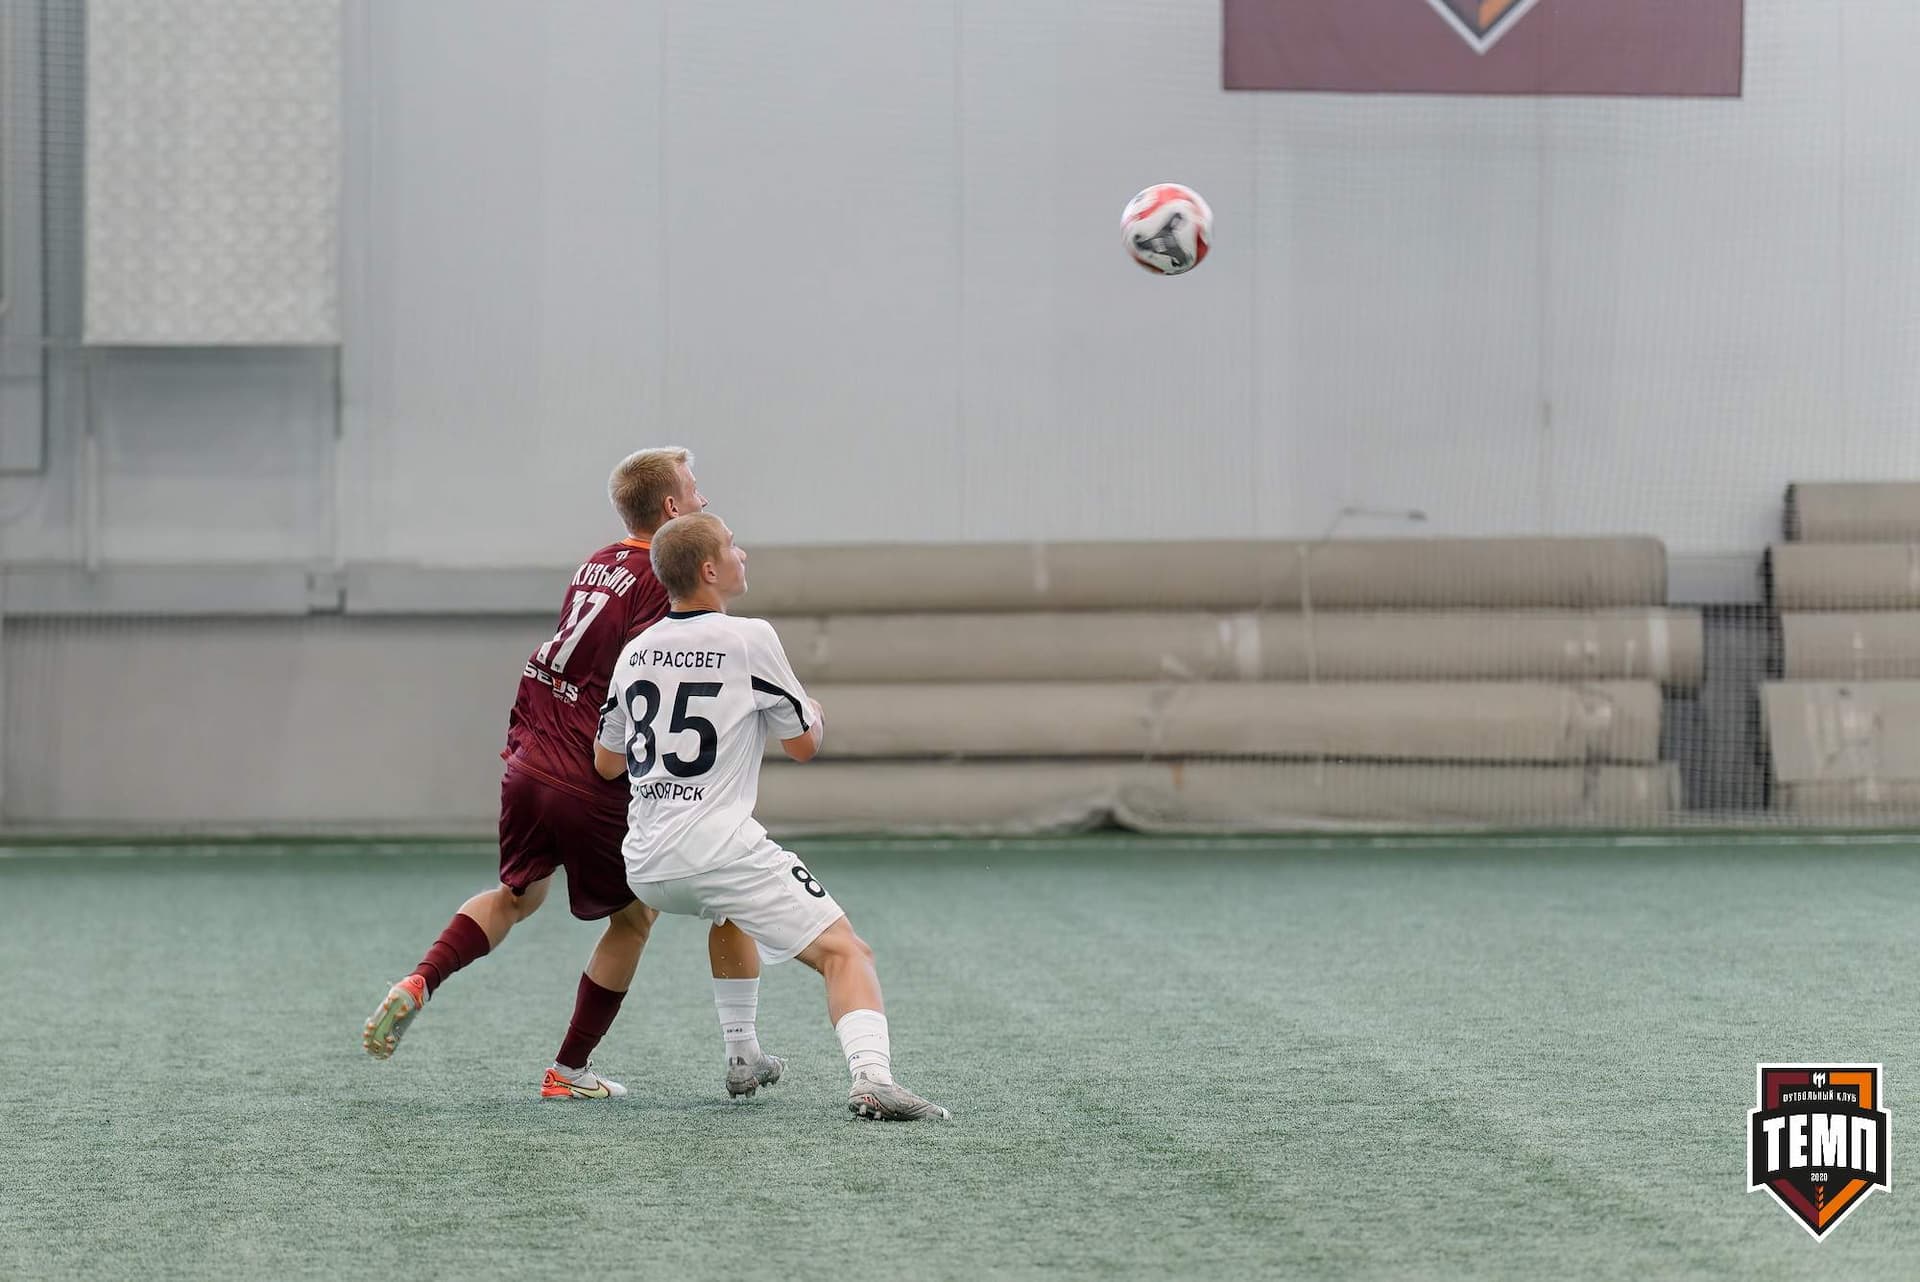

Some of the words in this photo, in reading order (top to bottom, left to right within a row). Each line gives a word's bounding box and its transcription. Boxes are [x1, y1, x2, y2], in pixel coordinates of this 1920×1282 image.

[629, 649, 648, 667] ФК
[652, 650, 726, 669] РАССВЕТ
[625, 679, 724, 778] 85
[791, 866, 826, 898] 8
